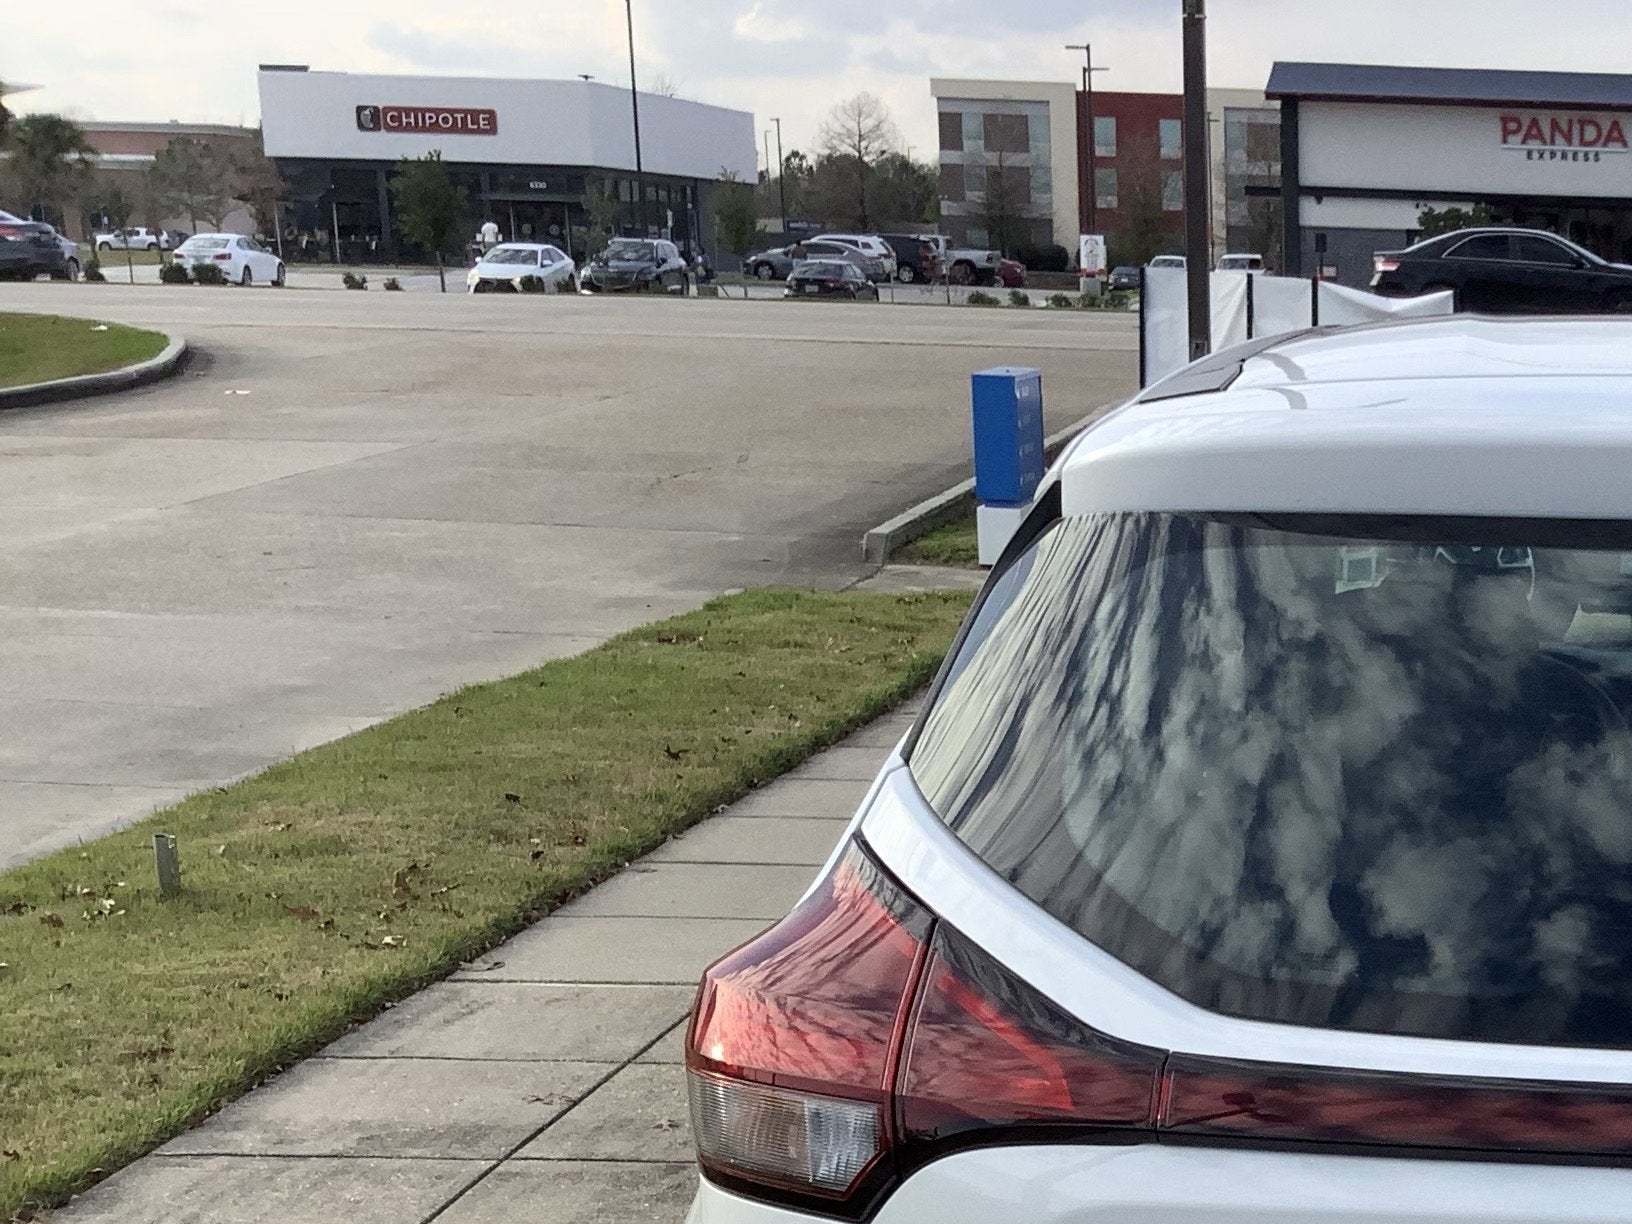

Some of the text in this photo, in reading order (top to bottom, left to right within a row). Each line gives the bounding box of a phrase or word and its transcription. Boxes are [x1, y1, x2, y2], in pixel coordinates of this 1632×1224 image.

[386, 110, 491, 130] CHIPOTLE
[1500, 116, 1628, 148] PANDA
[1526, 151, 1601, 162] EXPRESS
